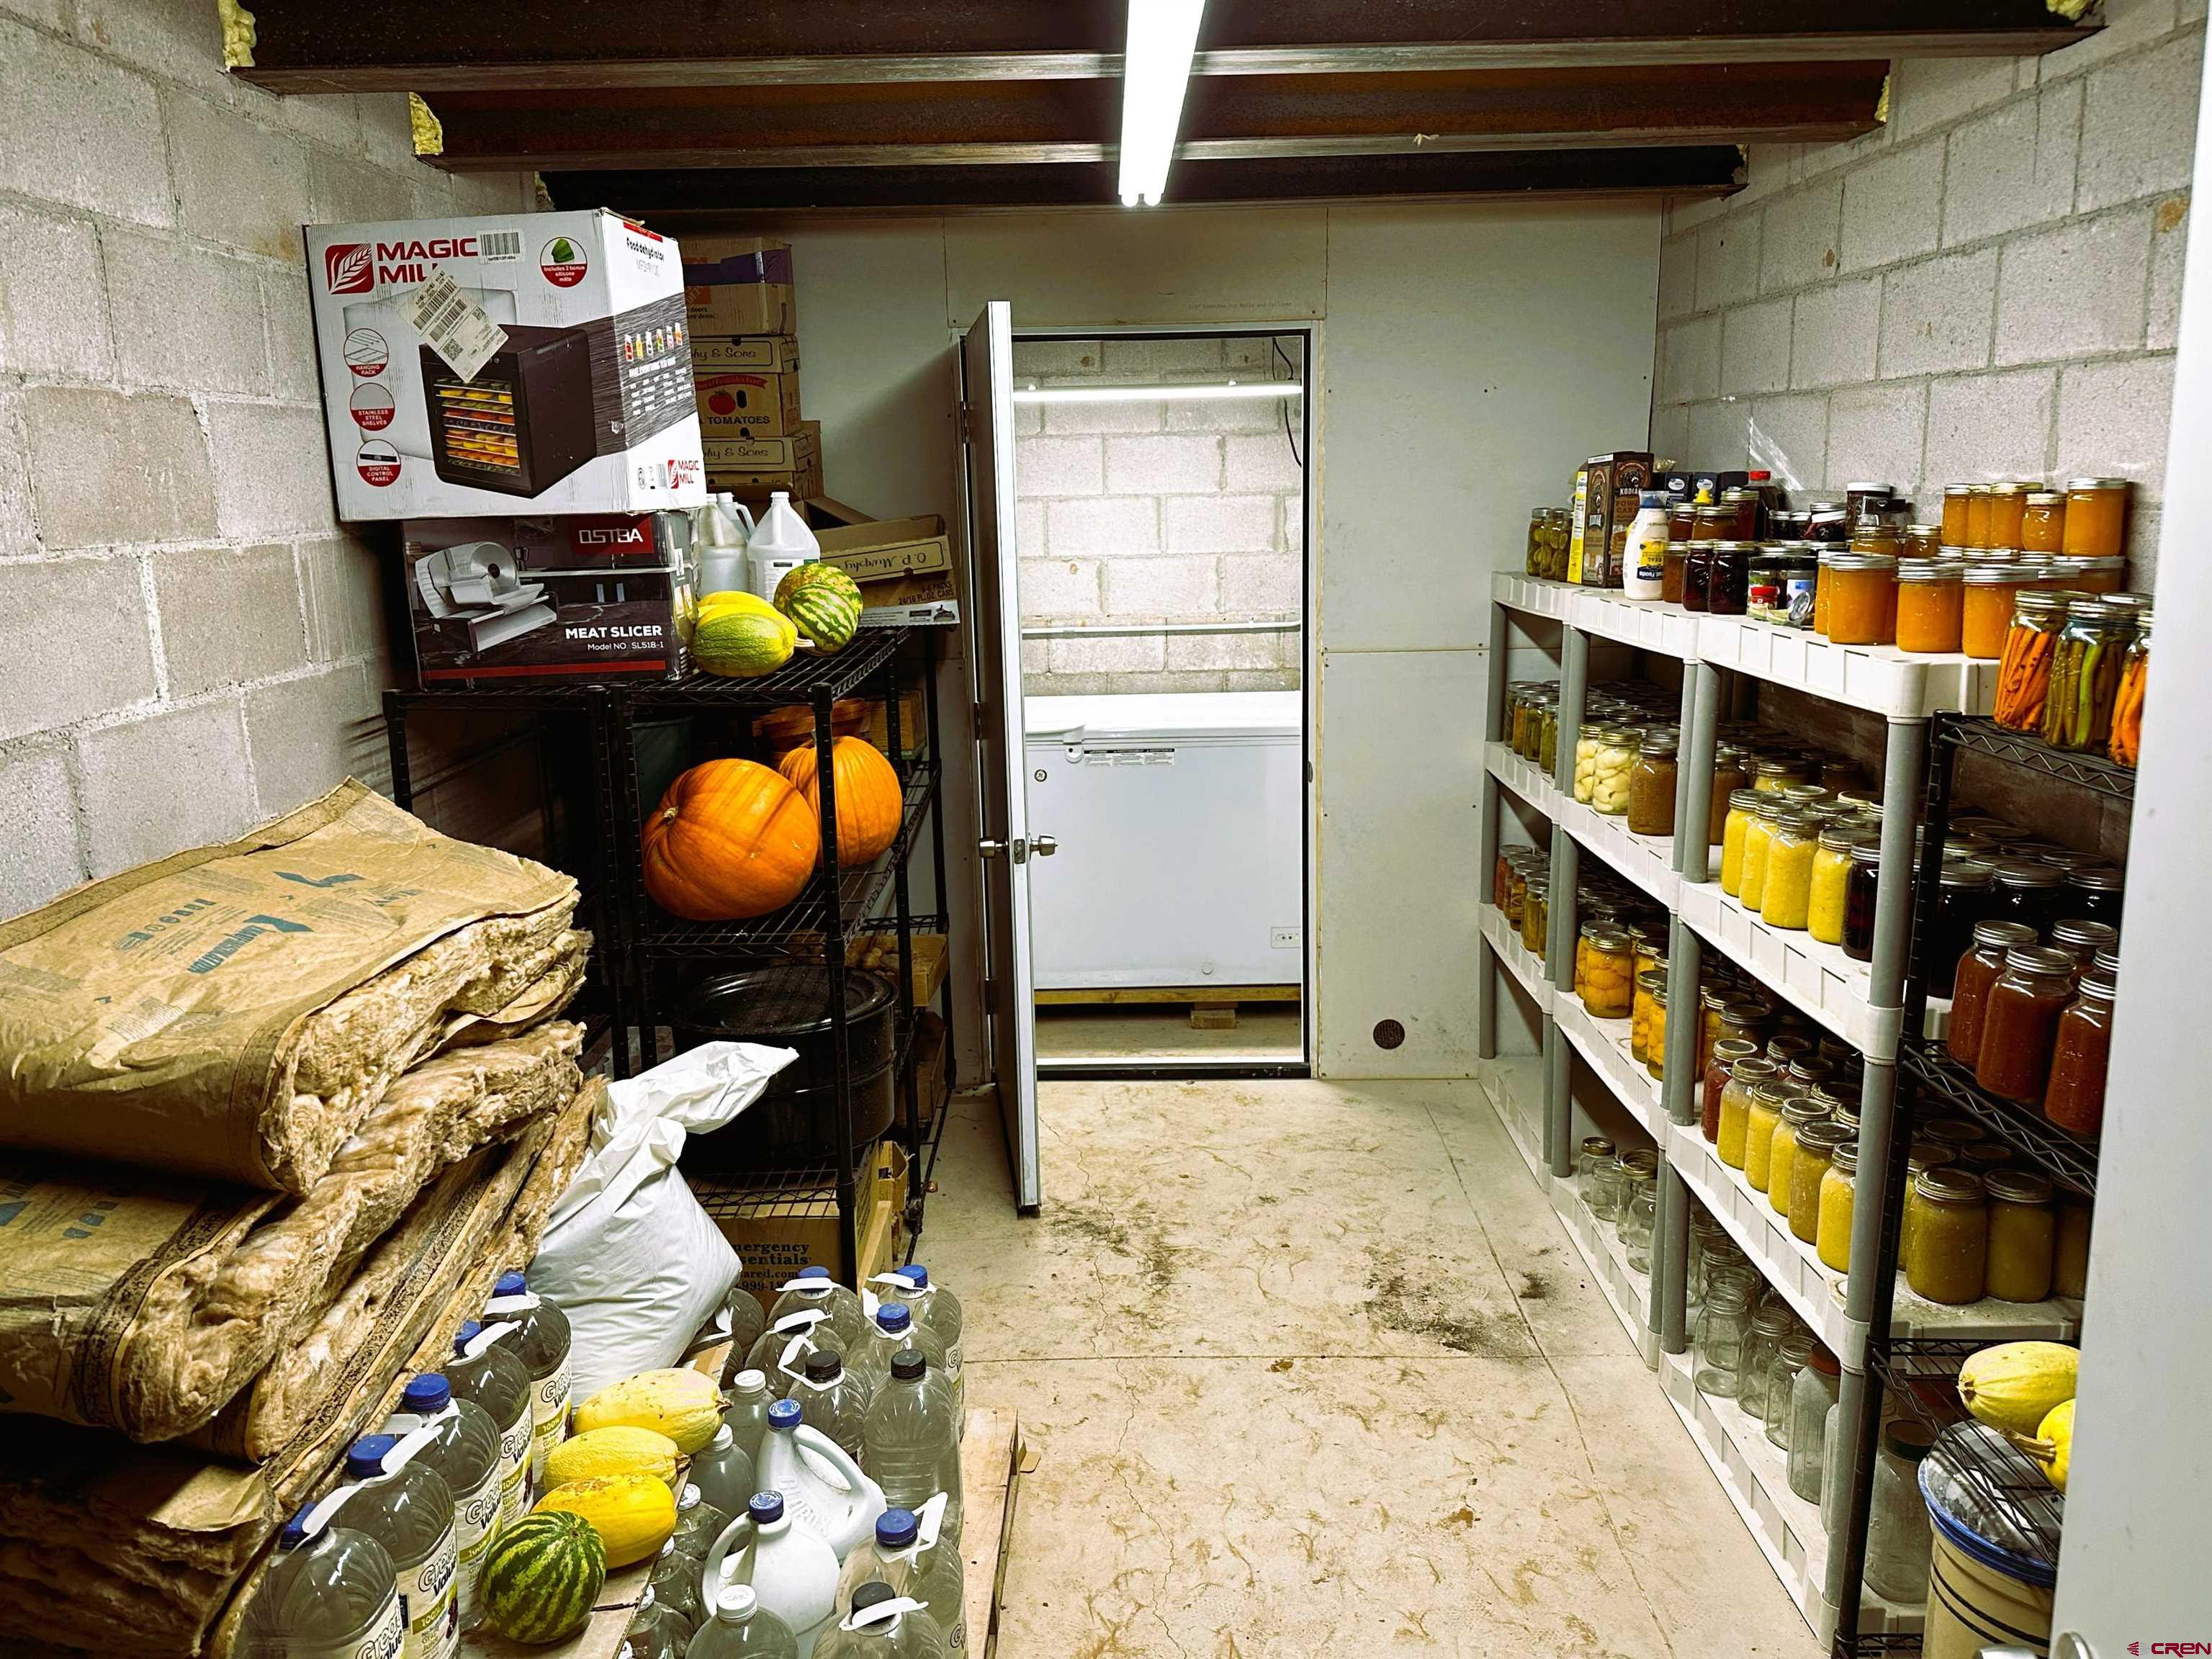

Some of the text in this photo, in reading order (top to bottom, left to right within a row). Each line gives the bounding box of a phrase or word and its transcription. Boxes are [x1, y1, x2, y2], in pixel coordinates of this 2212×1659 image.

[376, 237, 479, 261] MAGIC
[378, 263, 439, 284] MIL
[711, 349, 721, 357] &
[725, 347, 756, 359] Sons
[707, 415, 771, 425] TOMATOES
[724, 447, 734, 457] &
[738, 446, 769, 457] Sons
[678, 460, 700, 471] MAGIC
[679, 473, 694, 484] MILL
[845, 555, 895, 572] Murphy
[565, 625, 663, 639] MEAT SLICER
[631, 641, 664, 649] SL518-1
[740, 1253, 809, 1265] sentials
[741, 1267, 799, 1278] ared.com
[418, 1538, 456, 1593] Great
